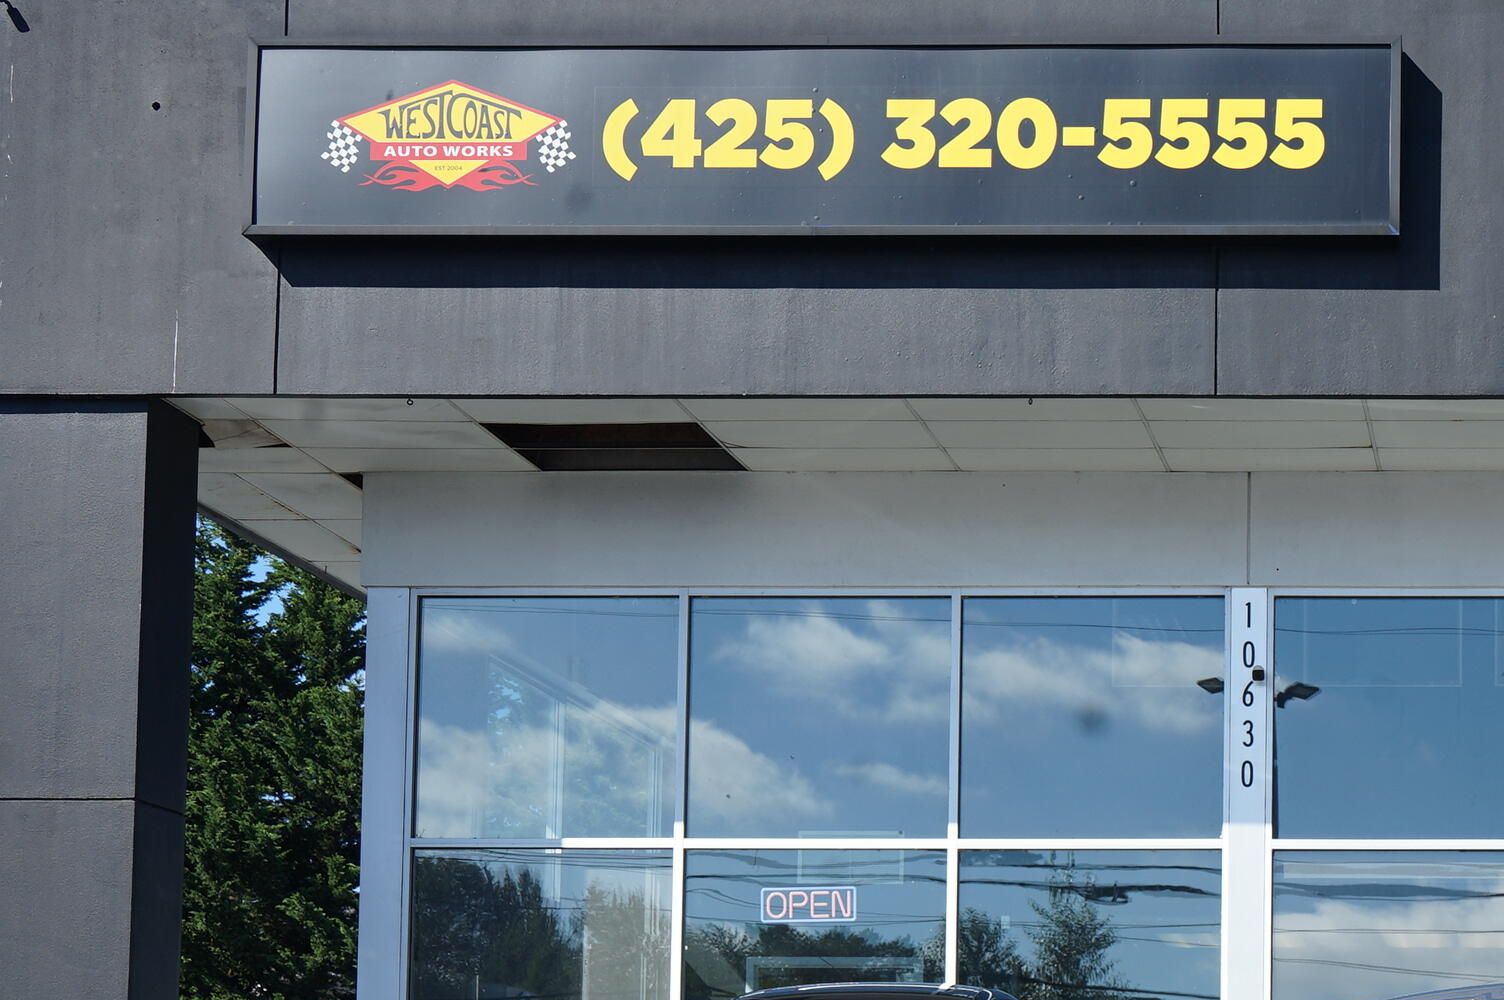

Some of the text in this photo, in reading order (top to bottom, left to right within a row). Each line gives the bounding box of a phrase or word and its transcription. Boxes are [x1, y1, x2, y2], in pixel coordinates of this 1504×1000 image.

[383, 145, 513, 157] AUTO WORKS
[602, 97, 1326, 182] (425) 320-5555
[766, 890, 851, 919] OPEN
